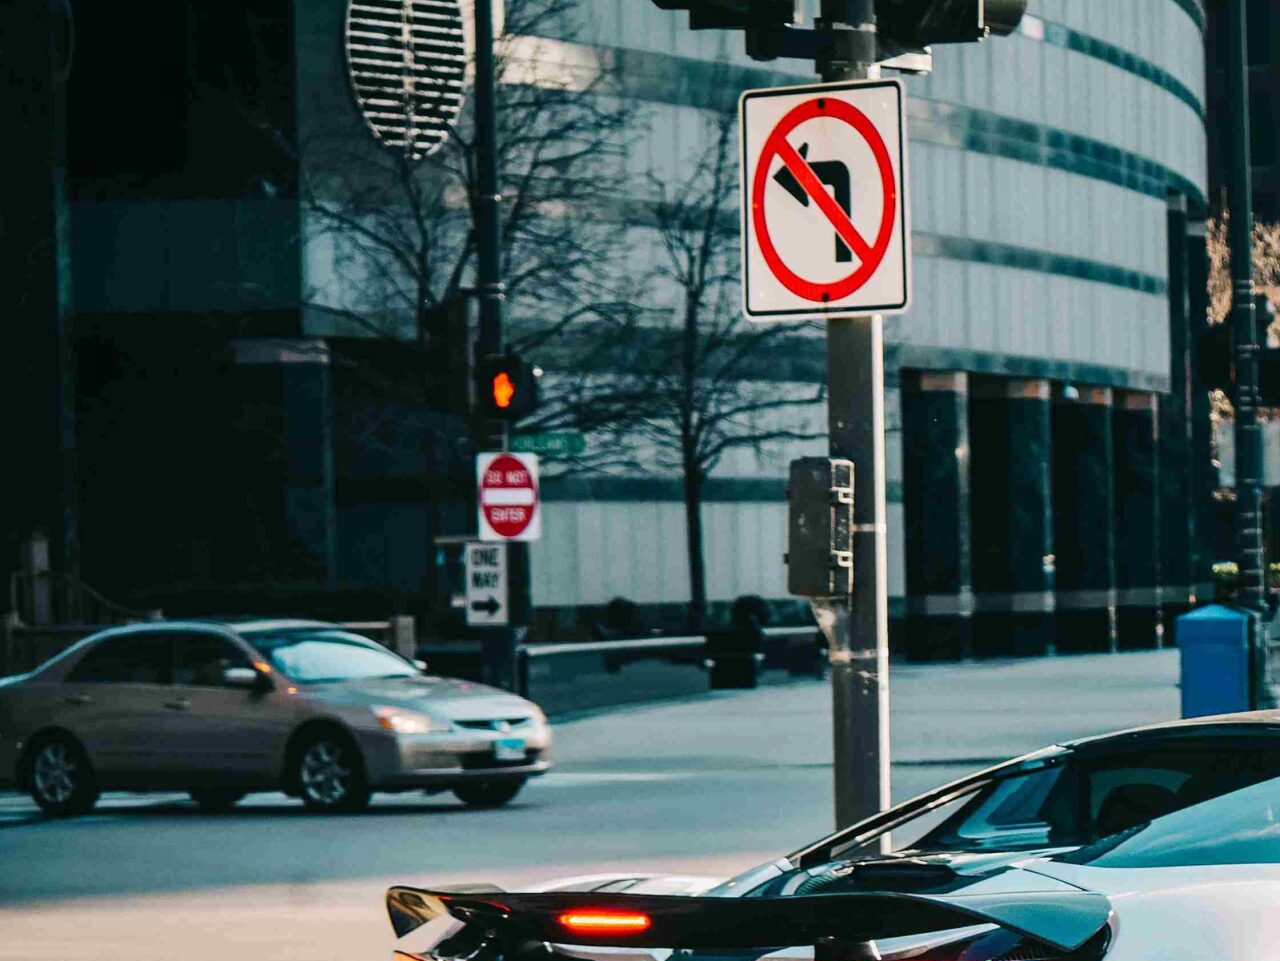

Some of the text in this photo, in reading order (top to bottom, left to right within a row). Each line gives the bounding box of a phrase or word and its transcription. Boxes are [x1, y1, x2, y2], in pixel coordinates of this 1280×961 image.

[487, 470, 528, 484] DO NOT
[491, 507, 525, 523] ENTER
[471, 548, 498, 567] ONE
[472, 571, 499, 589] WAY
